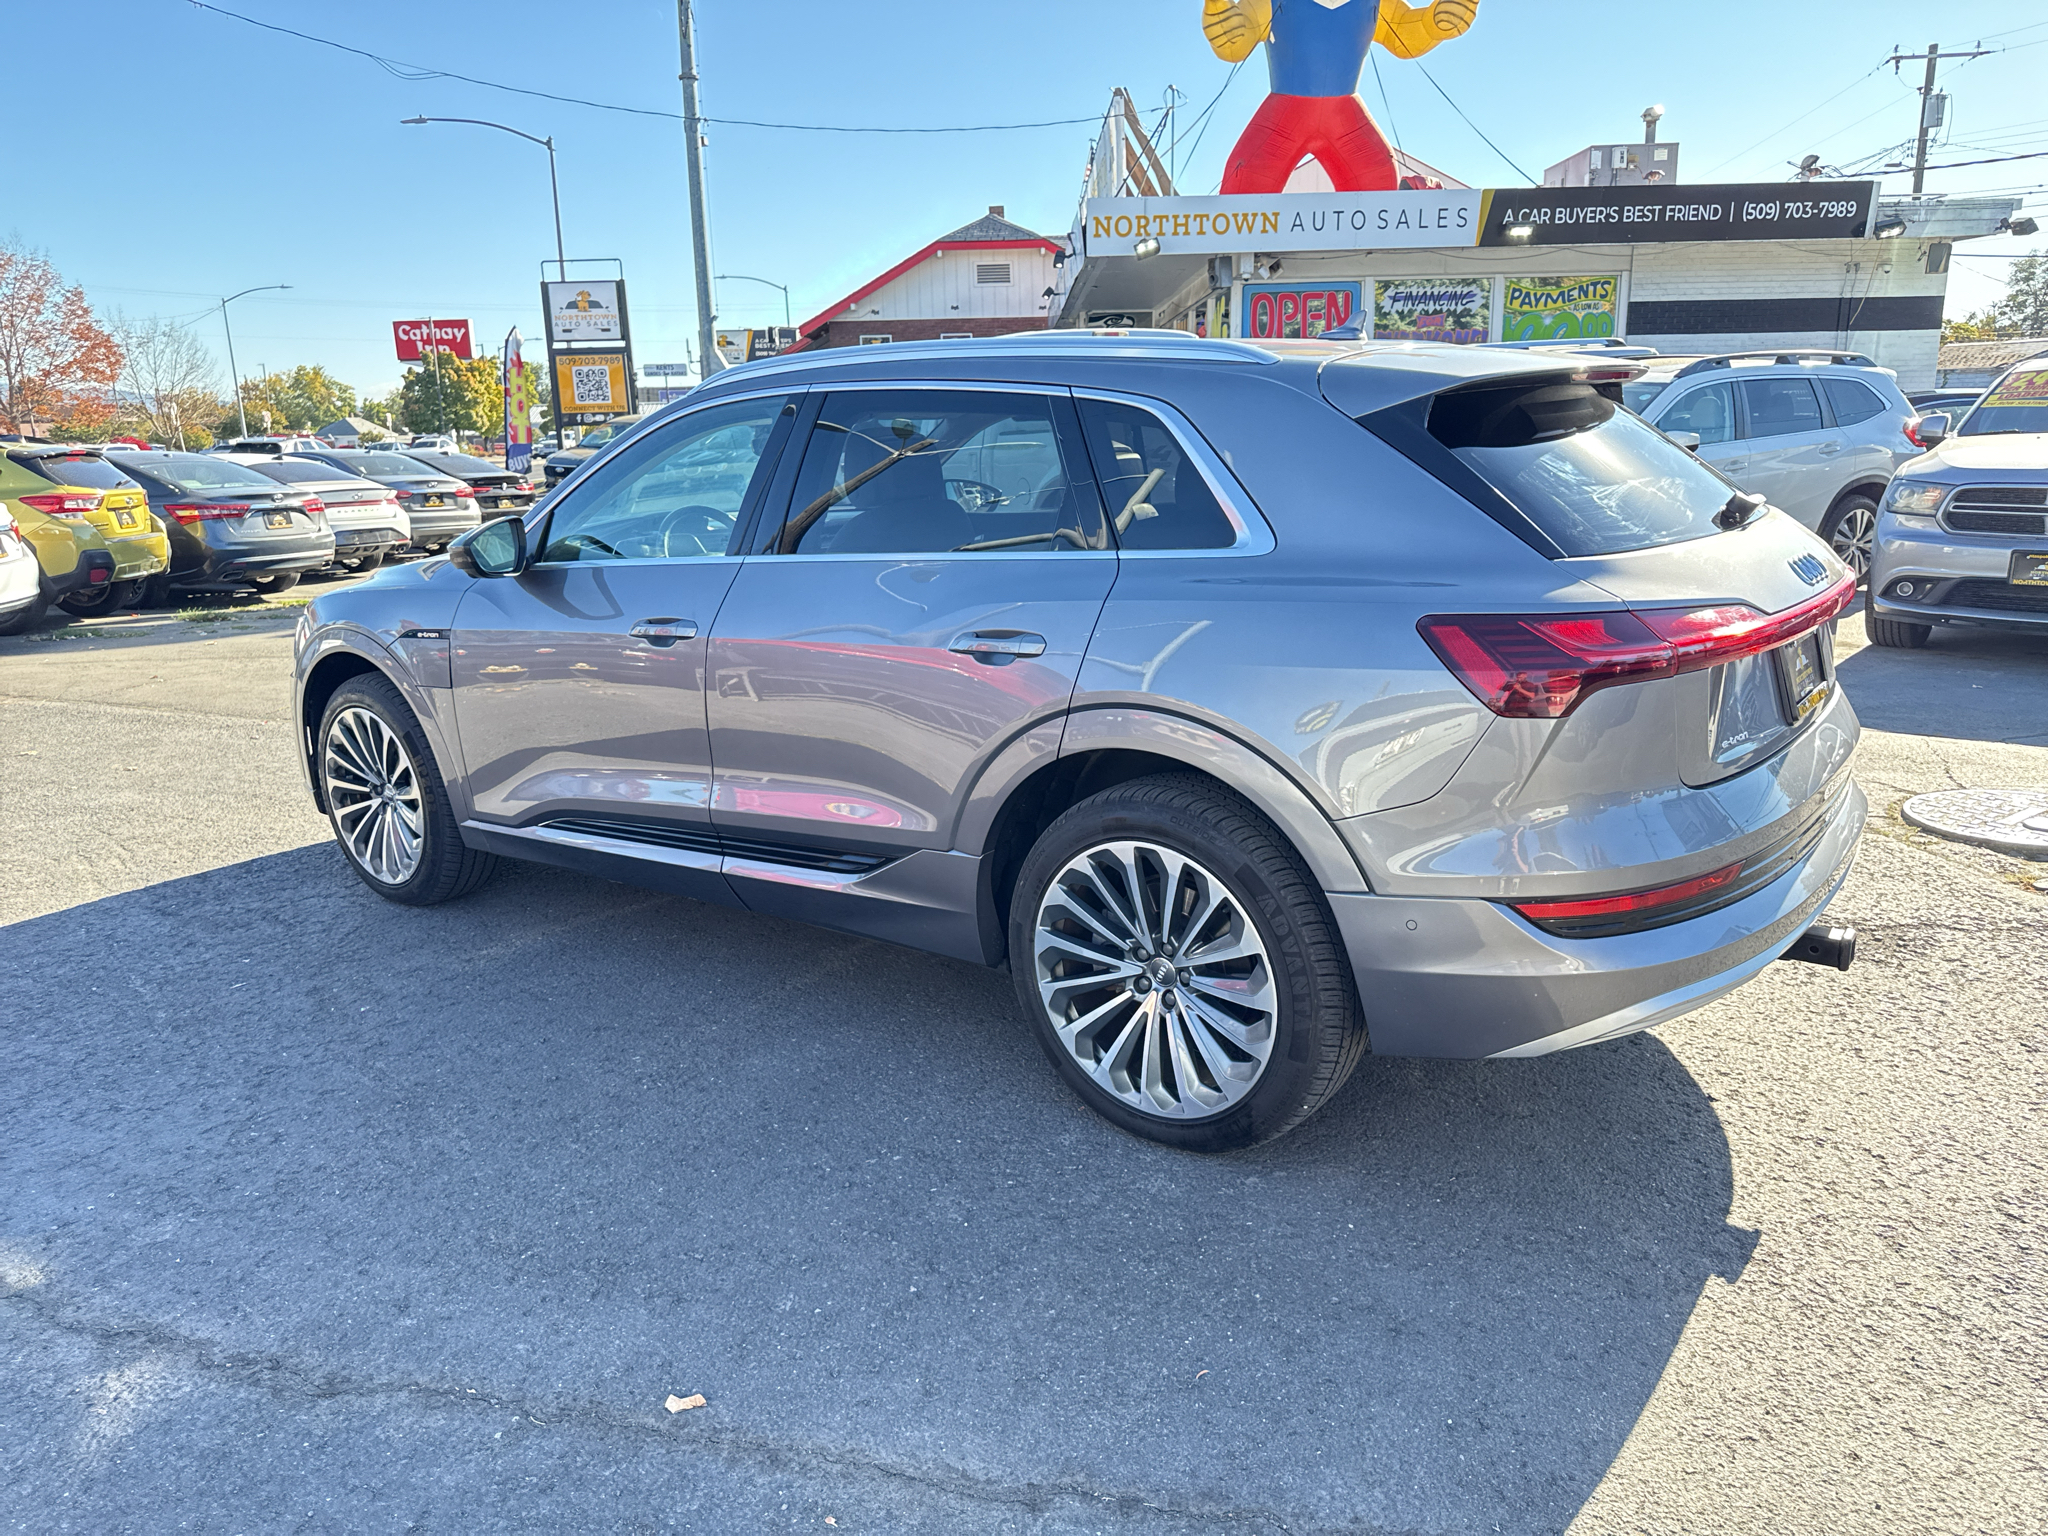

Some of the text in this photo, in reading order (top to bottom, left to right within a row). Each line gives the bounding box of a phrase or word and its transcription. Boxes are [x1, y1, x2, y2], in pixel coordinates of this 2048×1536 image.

[1503, 200, 1857, 224] A CAR BUYER'S BEST FRIEND (509) 703-7989
[1093, 206, 1469, 239] NORTHTOWN AUTO SALES
[1390, 290, 1477, 308] FINANCING
[1509, 280, 1612, 309] PAYMENTS
[1250, 291, 1352, 339] OPEN
[1573, 302, 1600, 311] AS LOW AS
[554, 314, 617, 322] NORTHTOWN
[587, 320, 618, 328] SALES
[1420, 316, 1443, 327] FOR
[398, 324, 466, 343] Cathay
[509, 367, 531, 444] HOT
[1721, 731, 1749, 749] e-tron
[1169, 814, 1217, 845] OUTSIDE
